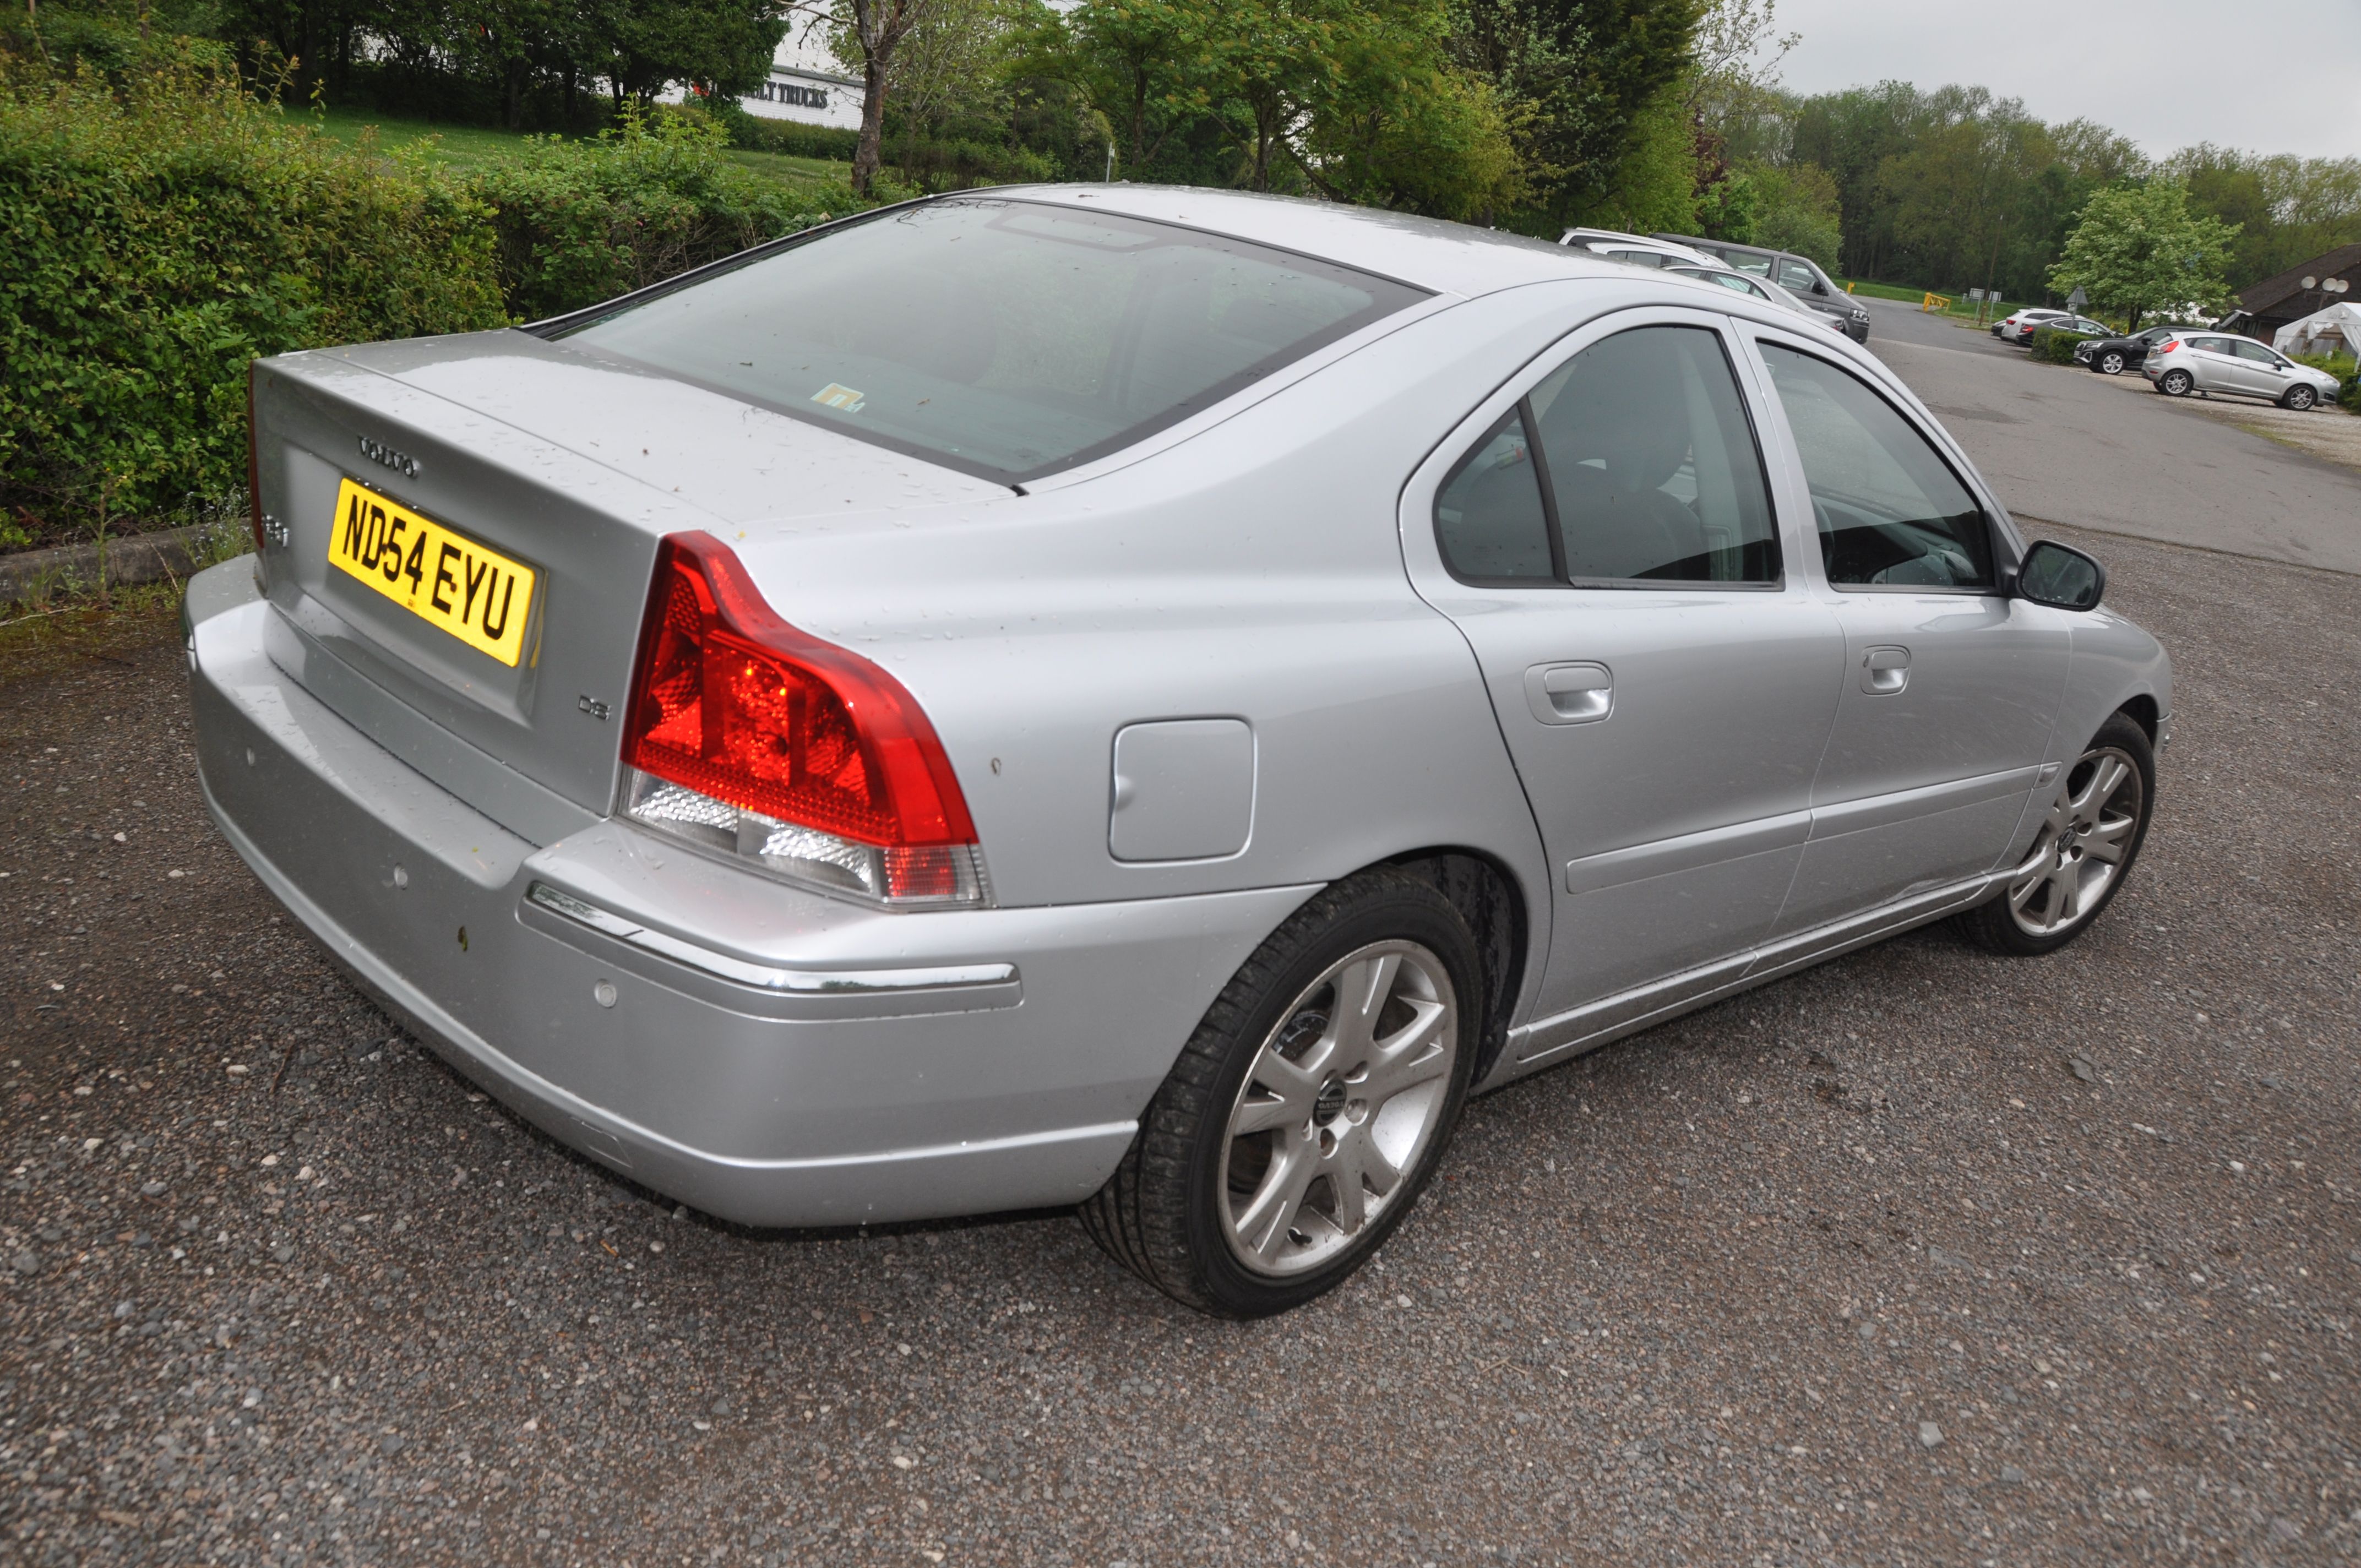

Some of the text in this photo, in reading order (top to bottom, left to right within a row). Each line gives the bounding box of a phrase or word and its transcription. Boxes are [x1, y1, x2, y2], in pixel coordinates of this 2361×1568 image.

[779, 83, 828, 109] TRUCKS
[357, 435, 420, 477] VOLVO
[342, 494, 515, 640] ND54 EYU
